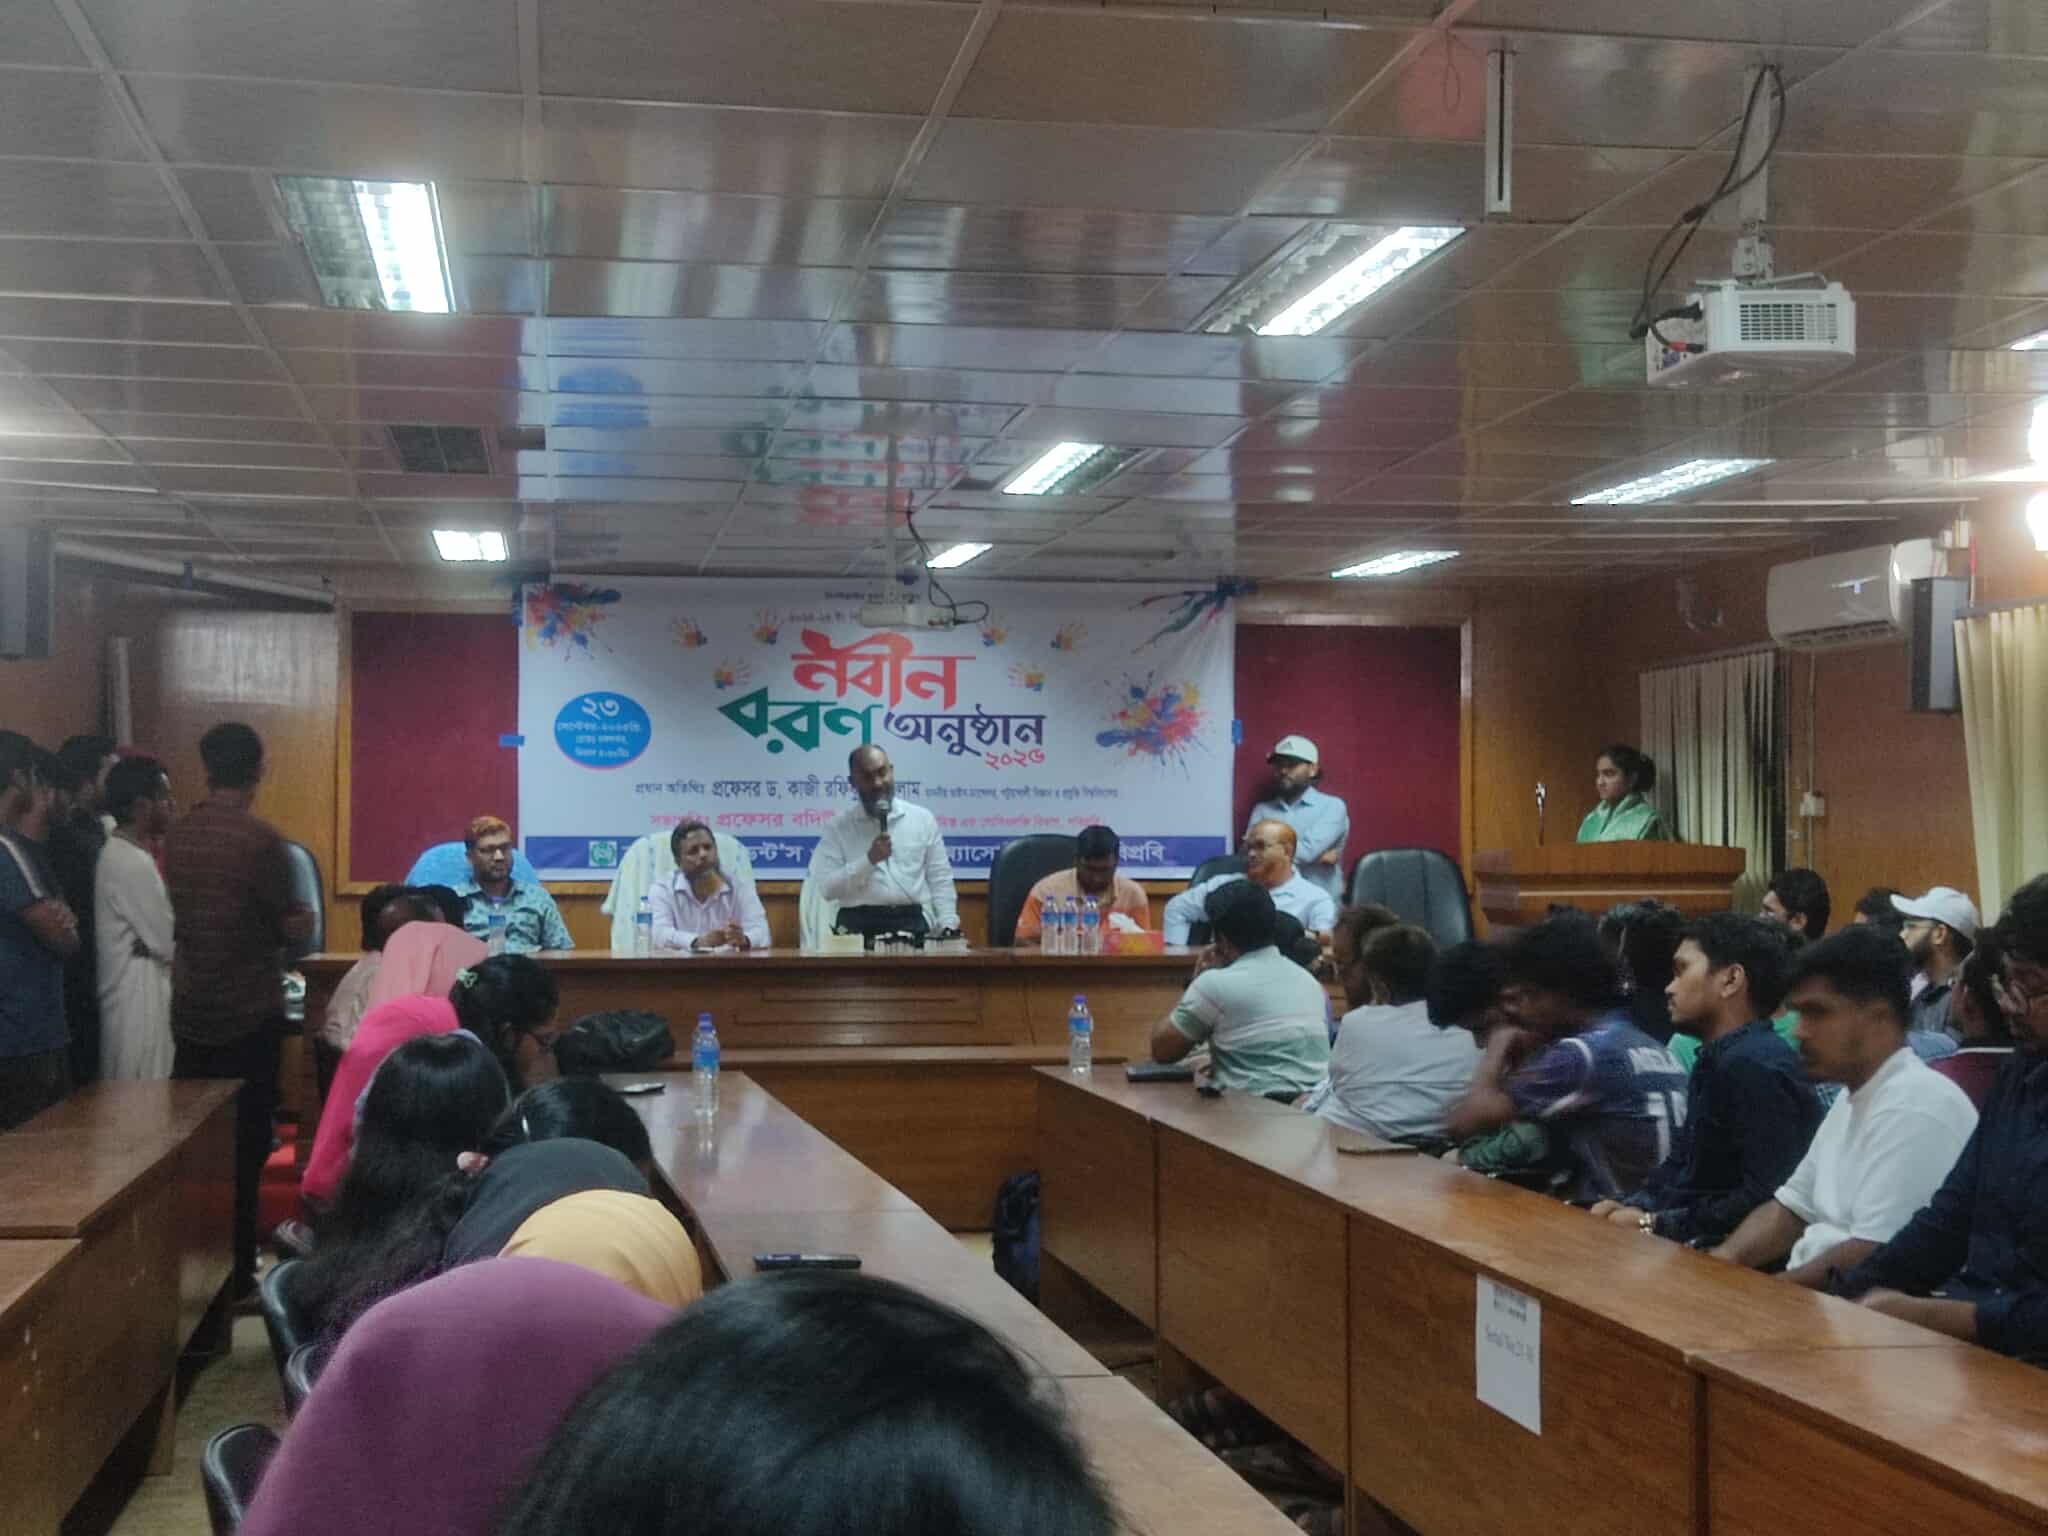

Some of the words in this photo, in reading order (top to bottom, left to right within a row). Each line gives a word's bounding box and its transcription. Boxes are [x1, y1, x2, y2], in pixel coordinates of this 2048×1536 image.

[791, 627, 977, 711] নবীন
[581, 698, 620, 720] ২৩
[717, 686, 884, 754] বরণ
[883, 703, 1046, 757] অনুষ্ঠান
[711, 780, 762, 798] প্রফেসর
[786, 774, 821, 798] কাজী
